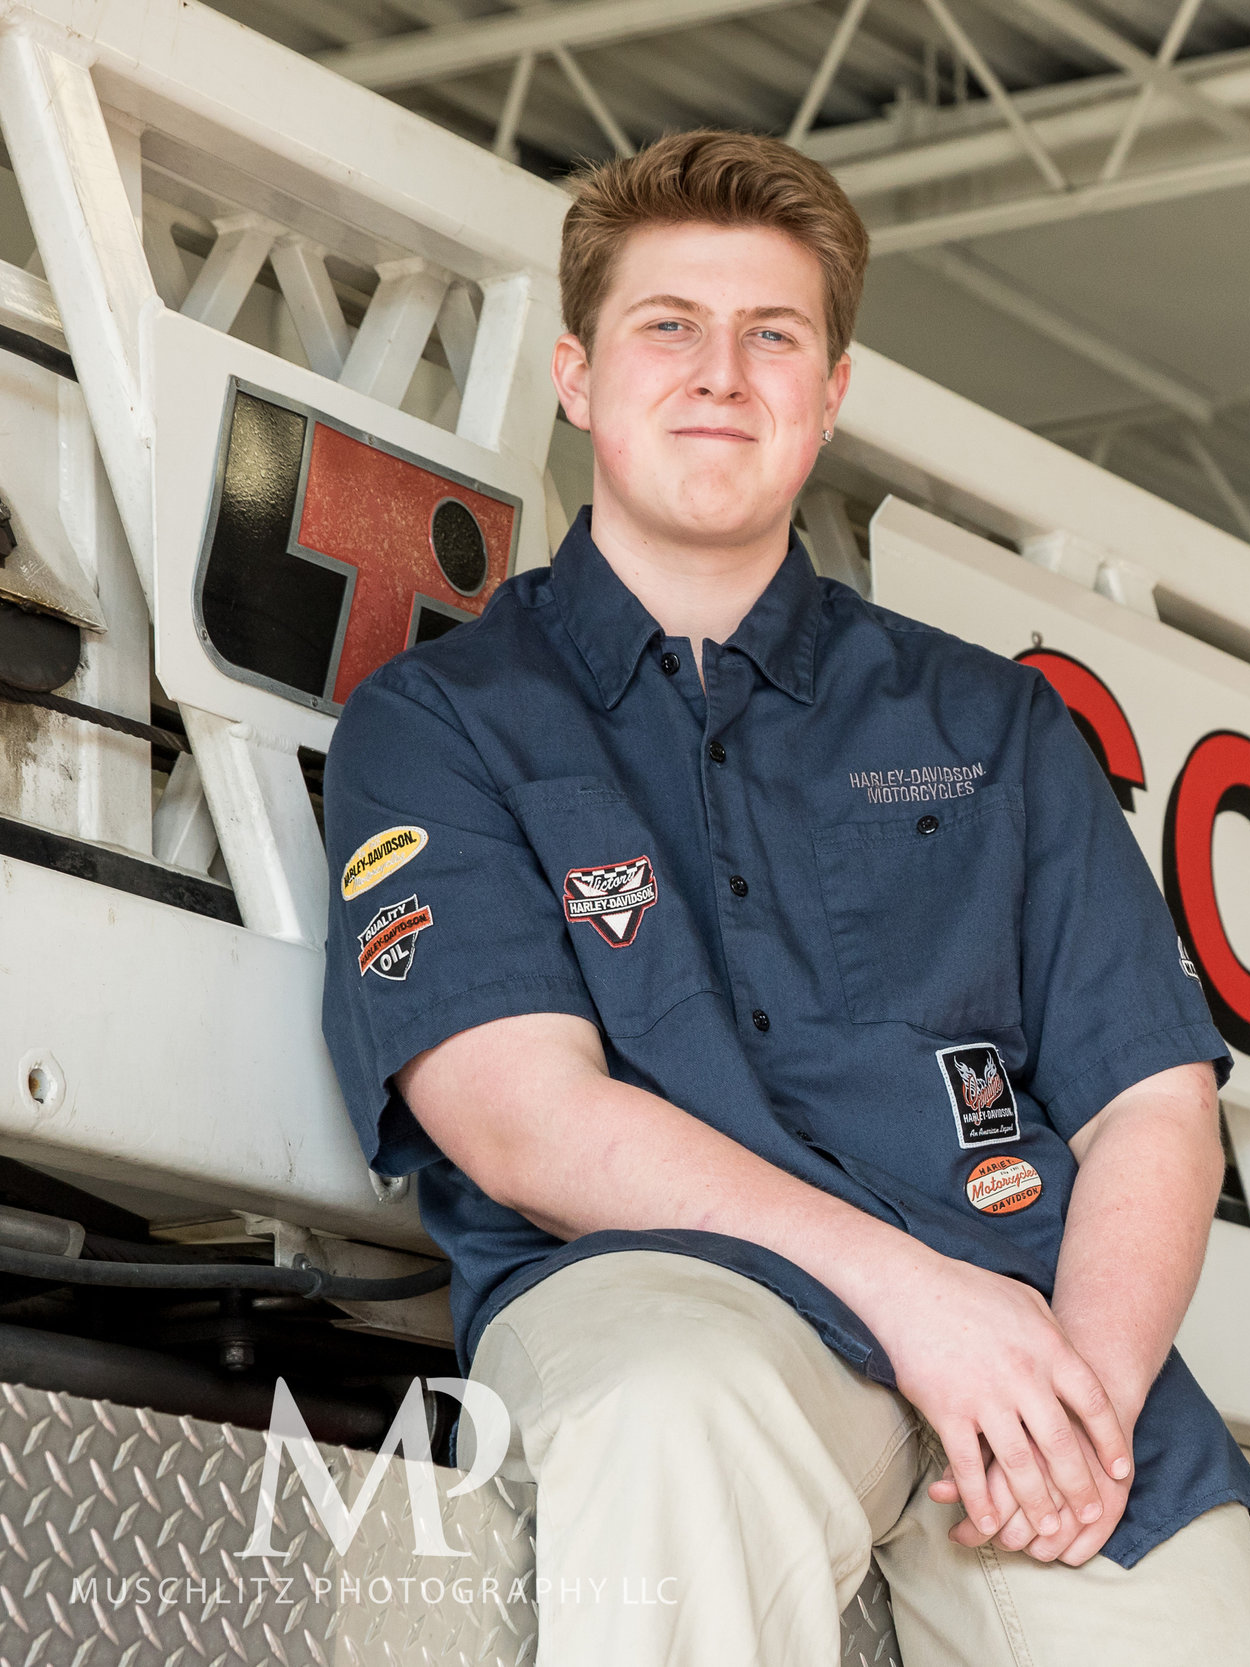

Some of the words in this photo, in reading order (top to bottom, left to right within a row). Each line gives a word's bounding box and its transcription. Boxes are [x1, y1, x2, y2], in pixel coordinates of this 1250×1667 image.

[867, 781, 975, 804] MOTORCYCLES
[365, 903, 406, 941] QUALITY
[380, 944, 409, 971] OIL
[992, 1187, 1038, 1212] DAVIDSON
